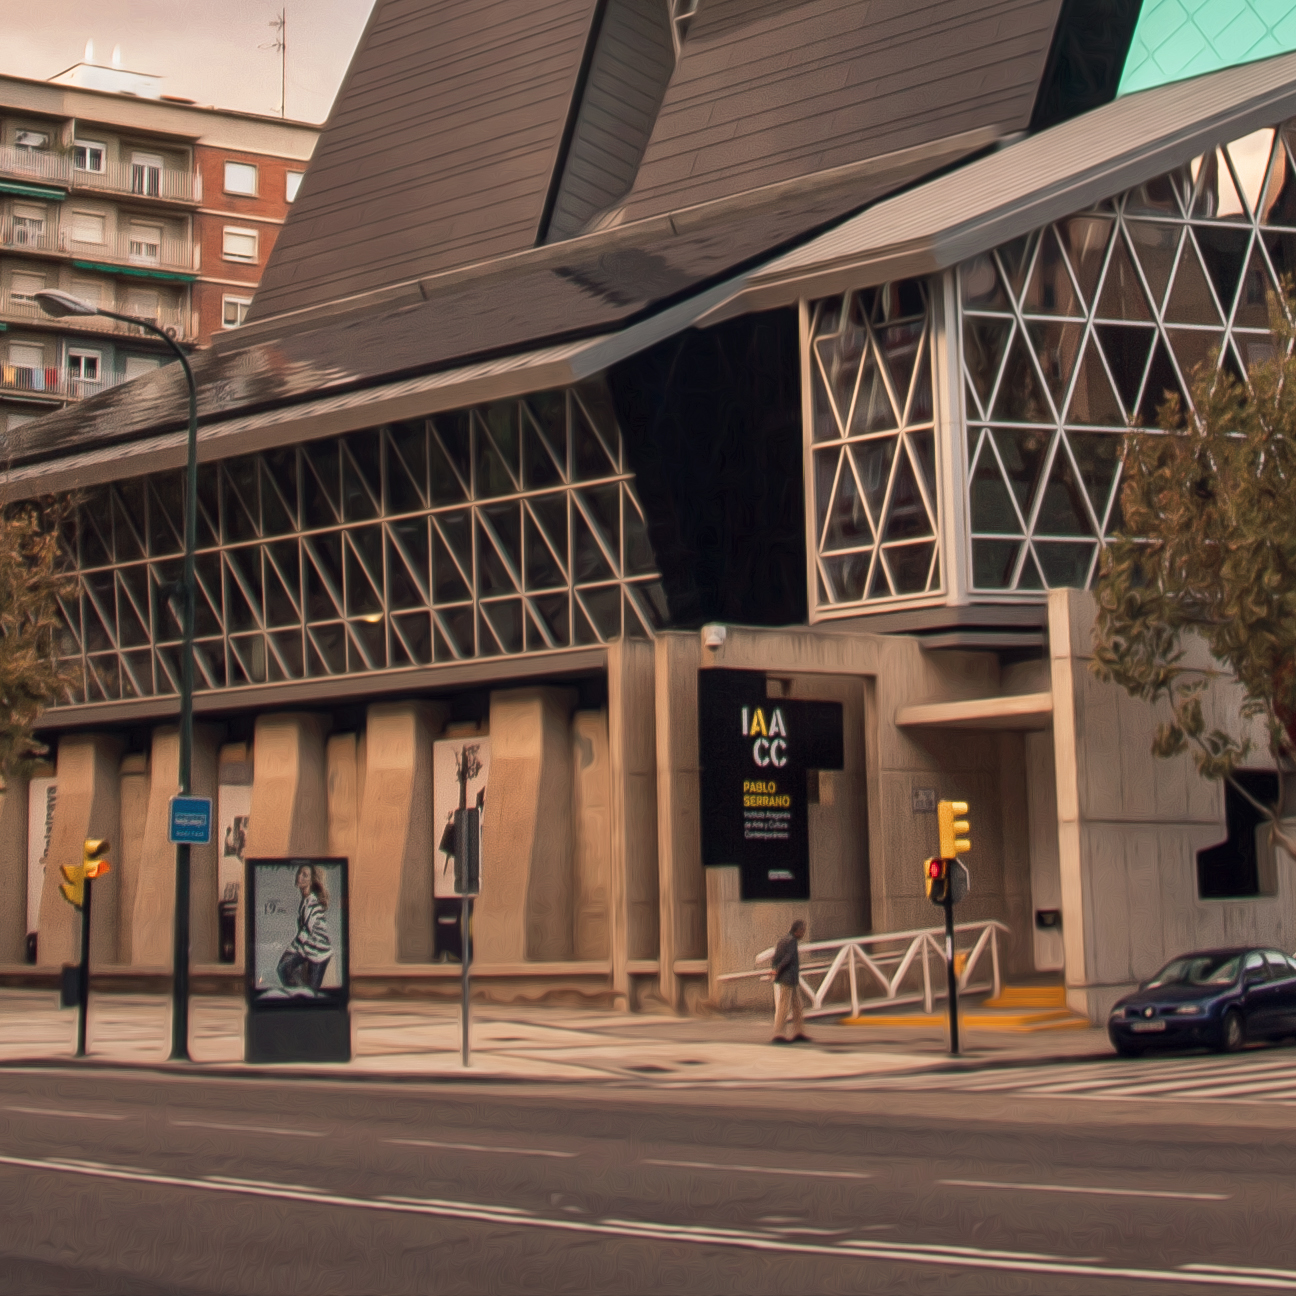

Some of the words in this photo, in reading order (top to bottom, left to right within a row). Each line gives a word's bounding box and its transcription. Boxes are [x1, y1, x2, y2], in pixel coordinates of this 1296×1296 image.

[741, 707, 787, 737] IAA
[753, 738, 787, 767] CC
[743, 781, 776, 794] PABLO
[743, 795, 791, 808] SERRANO
